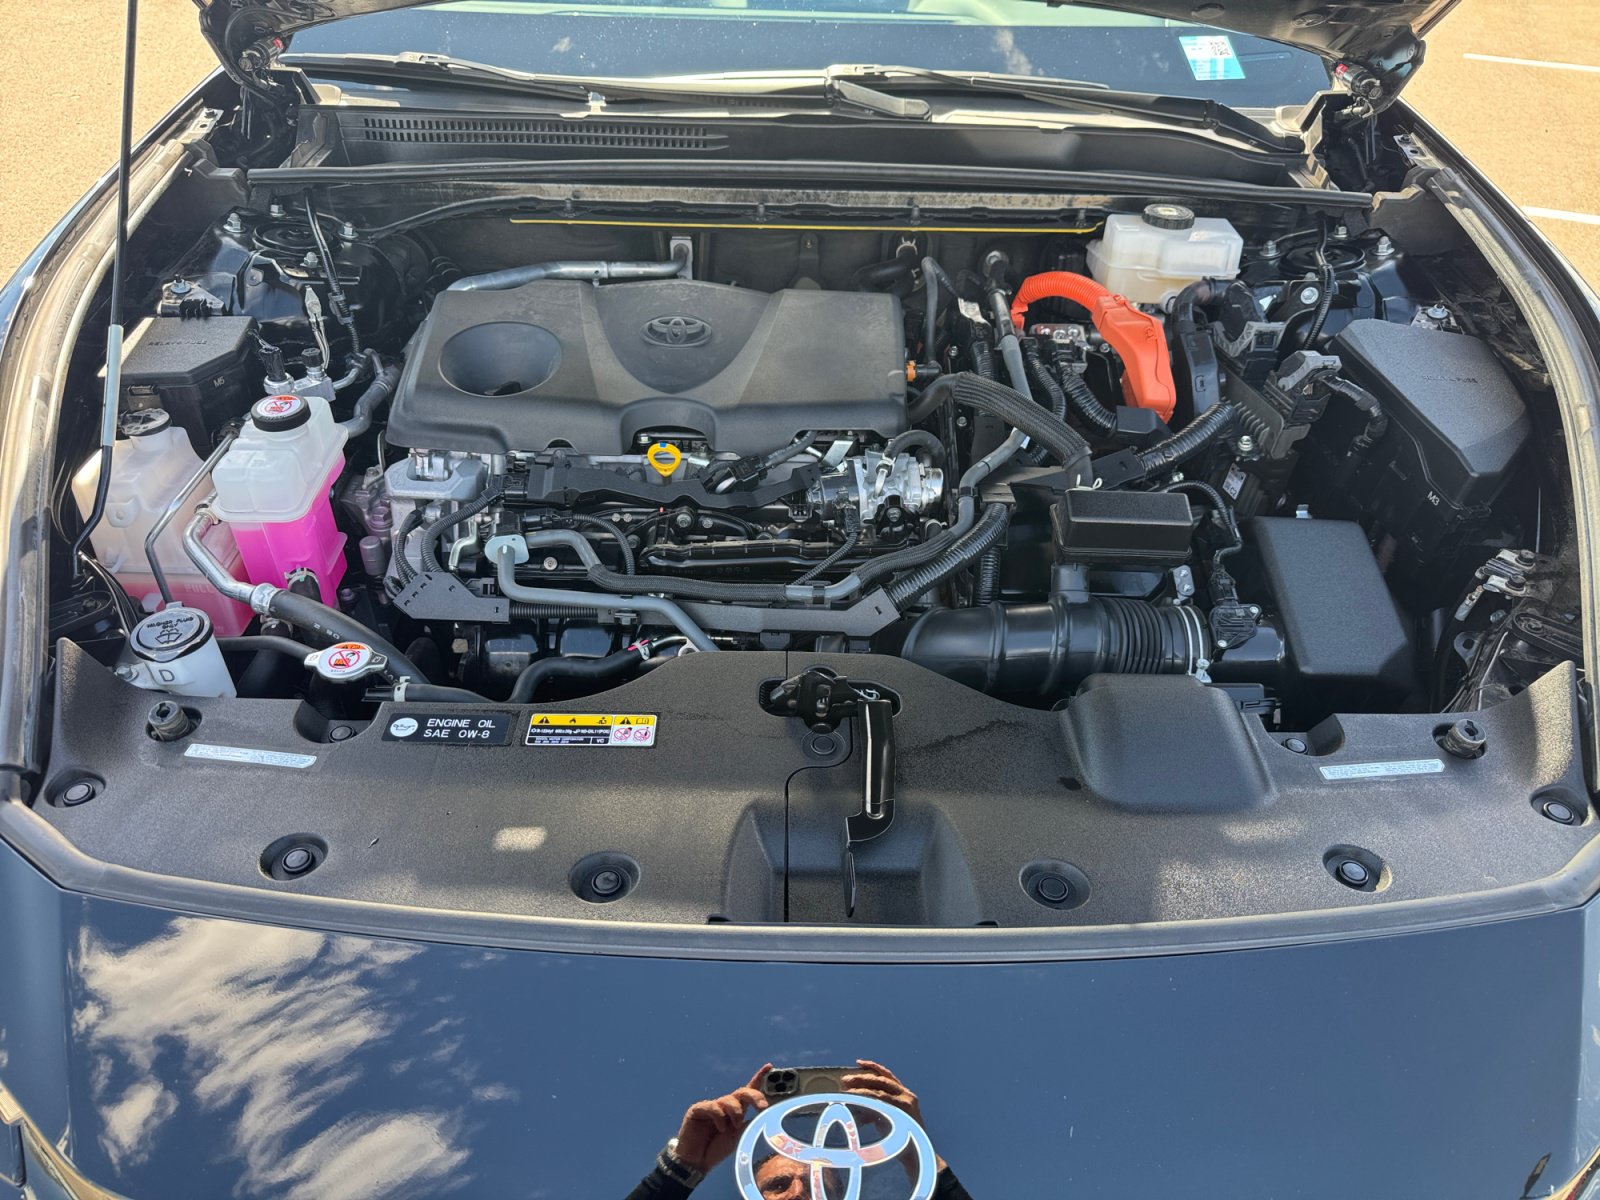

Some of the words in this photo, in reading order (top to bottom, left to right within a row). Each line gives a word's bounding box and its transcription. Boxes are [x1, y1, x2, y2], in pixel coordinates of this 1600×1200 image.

[1427, 490, 1440, 506] M3
[184, 583, 215, 594] FULL
[158, 669, 175, 682] D
[427, 718, 471, 728] ENGINE
[478, 719, 496, 728] OIL
[423, 729, 451, 738] SAE
[458, 729, 490, 739] 0W-8
